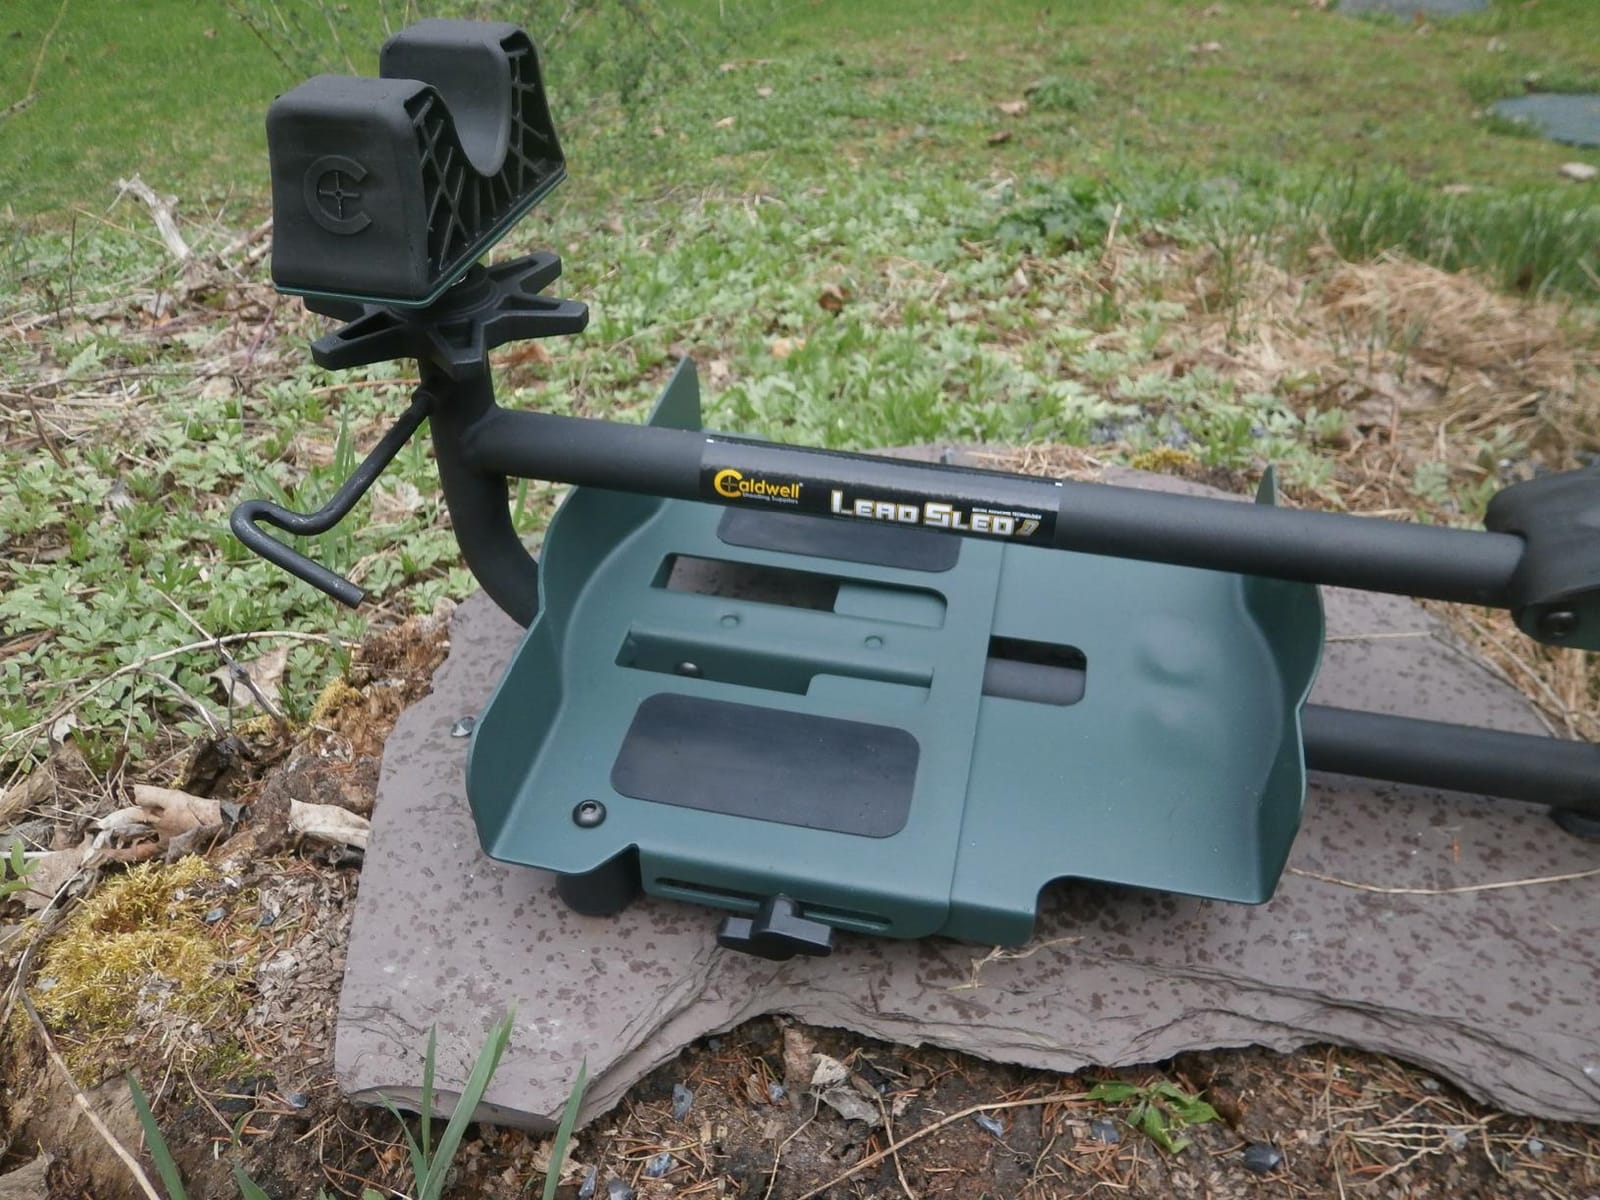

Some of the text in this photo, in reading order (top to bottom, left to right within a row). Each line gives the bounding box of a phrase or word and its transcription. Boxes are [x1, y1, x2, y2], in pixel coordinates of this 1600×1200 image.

[714, 468, 799, 499] Caldwell
[831, 489, 920, 523] LEAD
[924, 502, 1015, 536] SLED
